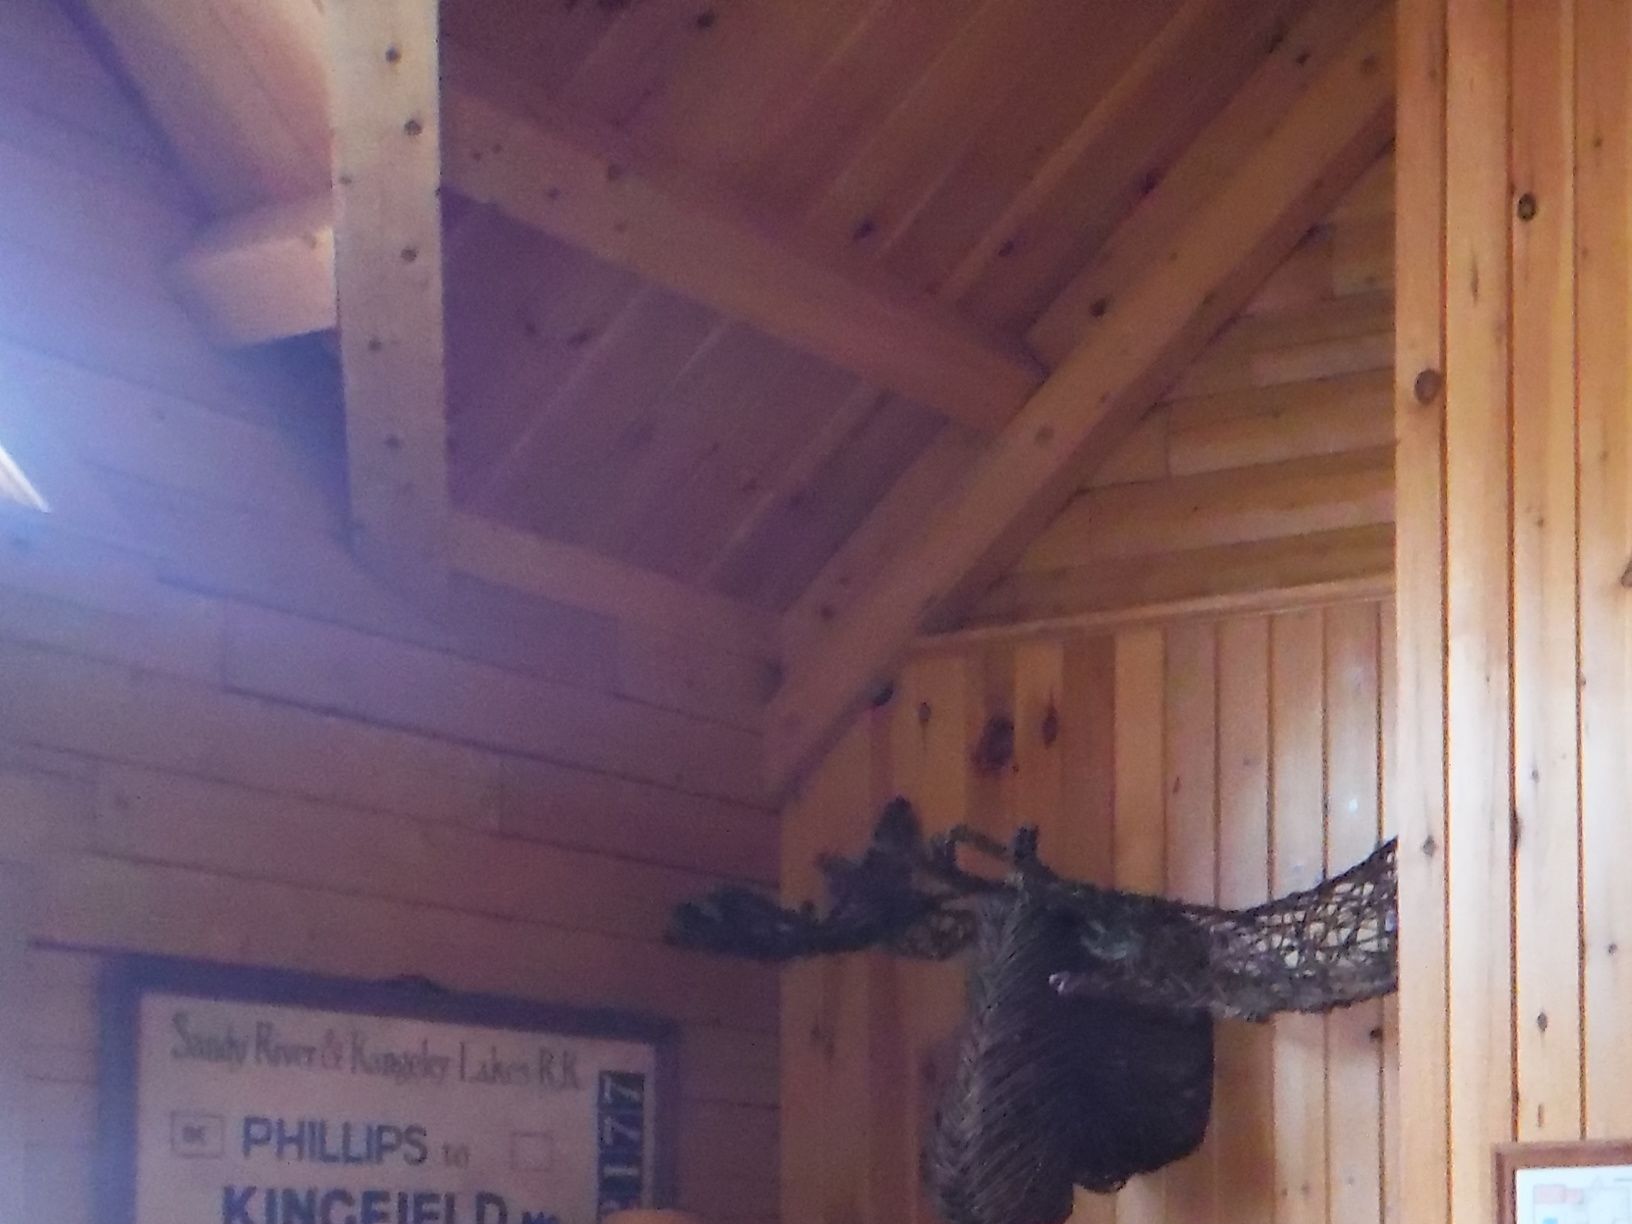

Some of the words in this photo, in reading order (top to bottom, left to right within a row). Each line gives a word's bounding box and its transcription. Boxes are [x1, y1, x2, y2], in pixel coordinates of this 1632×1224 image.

[254, 1020, 317, 1068] River
[320, 1028, 343, 1070] &
[459, 1040, 531, 1085] Lakes
[241, 1115, 429, 1166] PHILLIPS
[440, 1141, 471, 1170] to
[600, 1075, 641, 1211] 177
